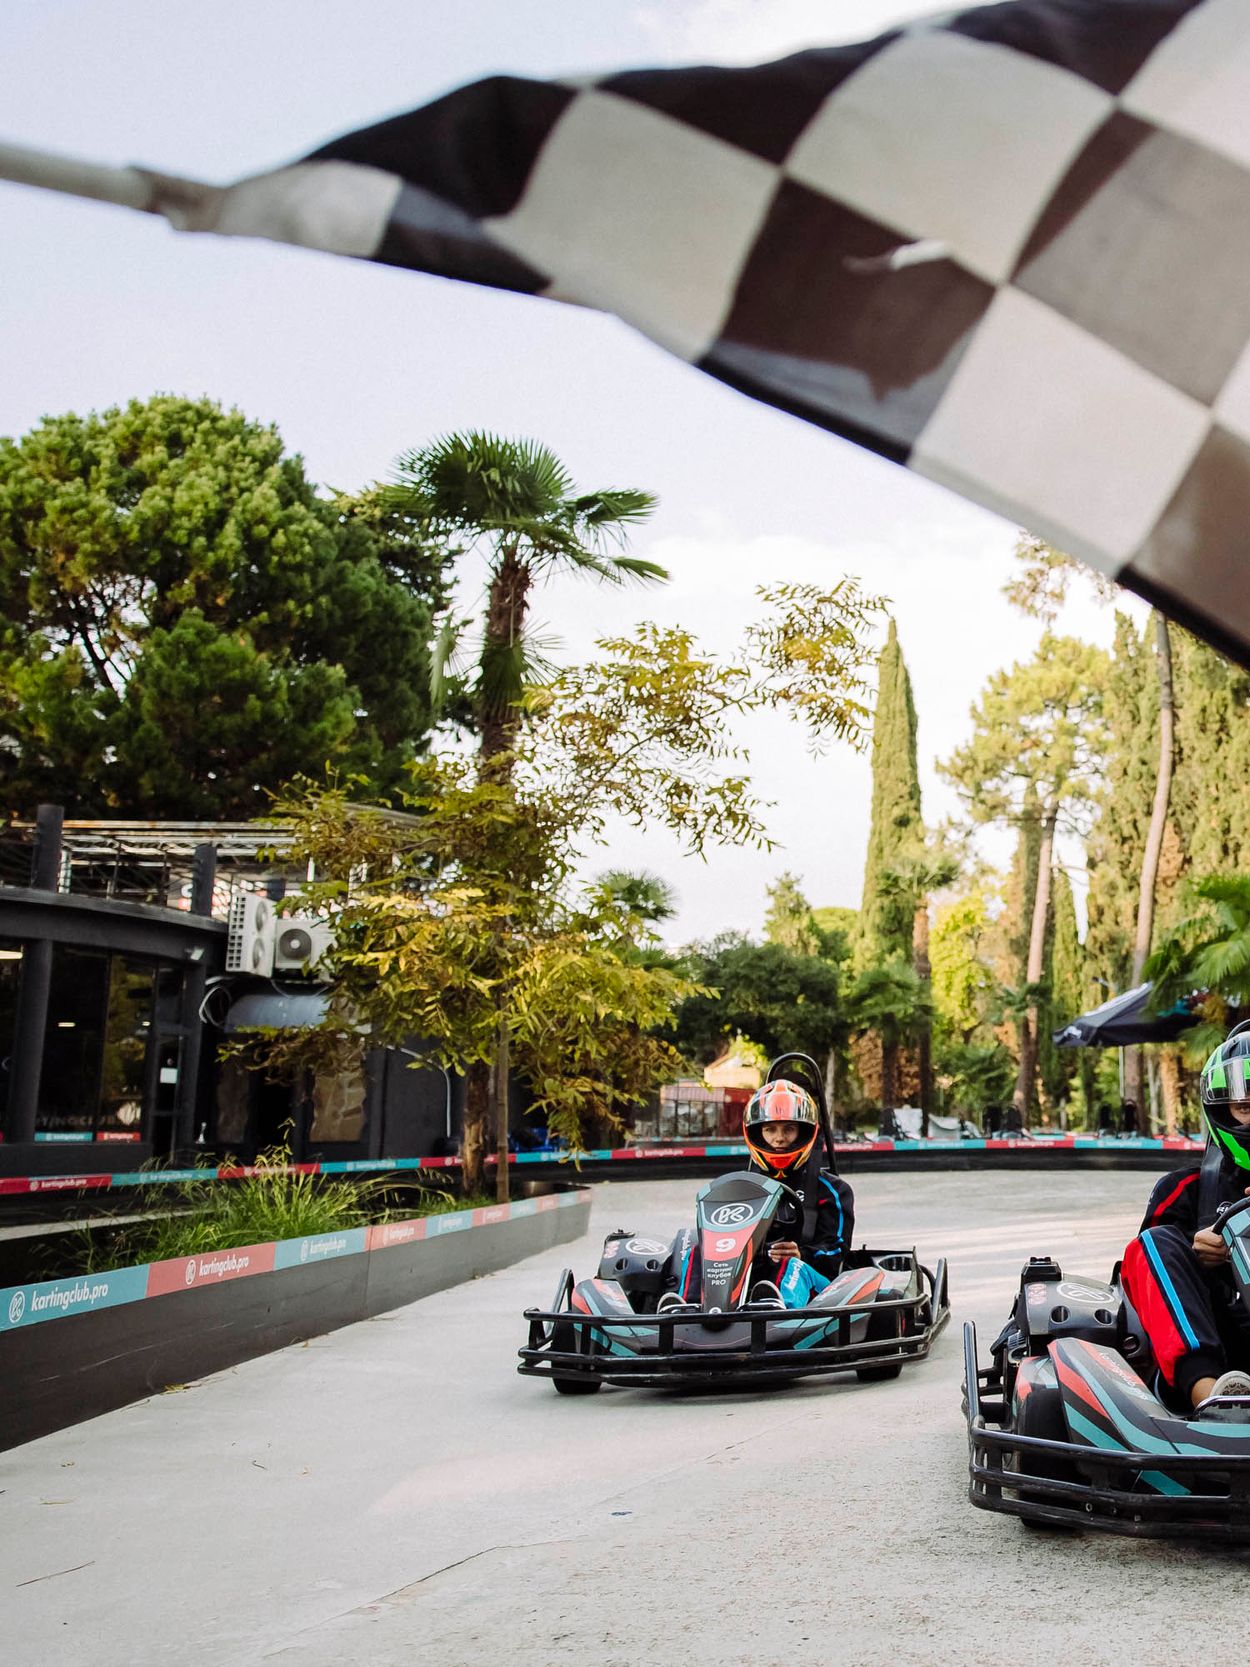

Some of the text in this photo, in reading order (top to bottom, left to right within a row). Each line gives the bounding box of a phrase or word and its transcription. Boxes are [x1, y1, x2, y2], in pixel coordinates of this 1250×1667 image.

[715, 1238, 736, 1253] 9
[199, 1254, 249, 1277] kartingclub.pro
[31, 1281, 109, 1312] kartingclub.pro
